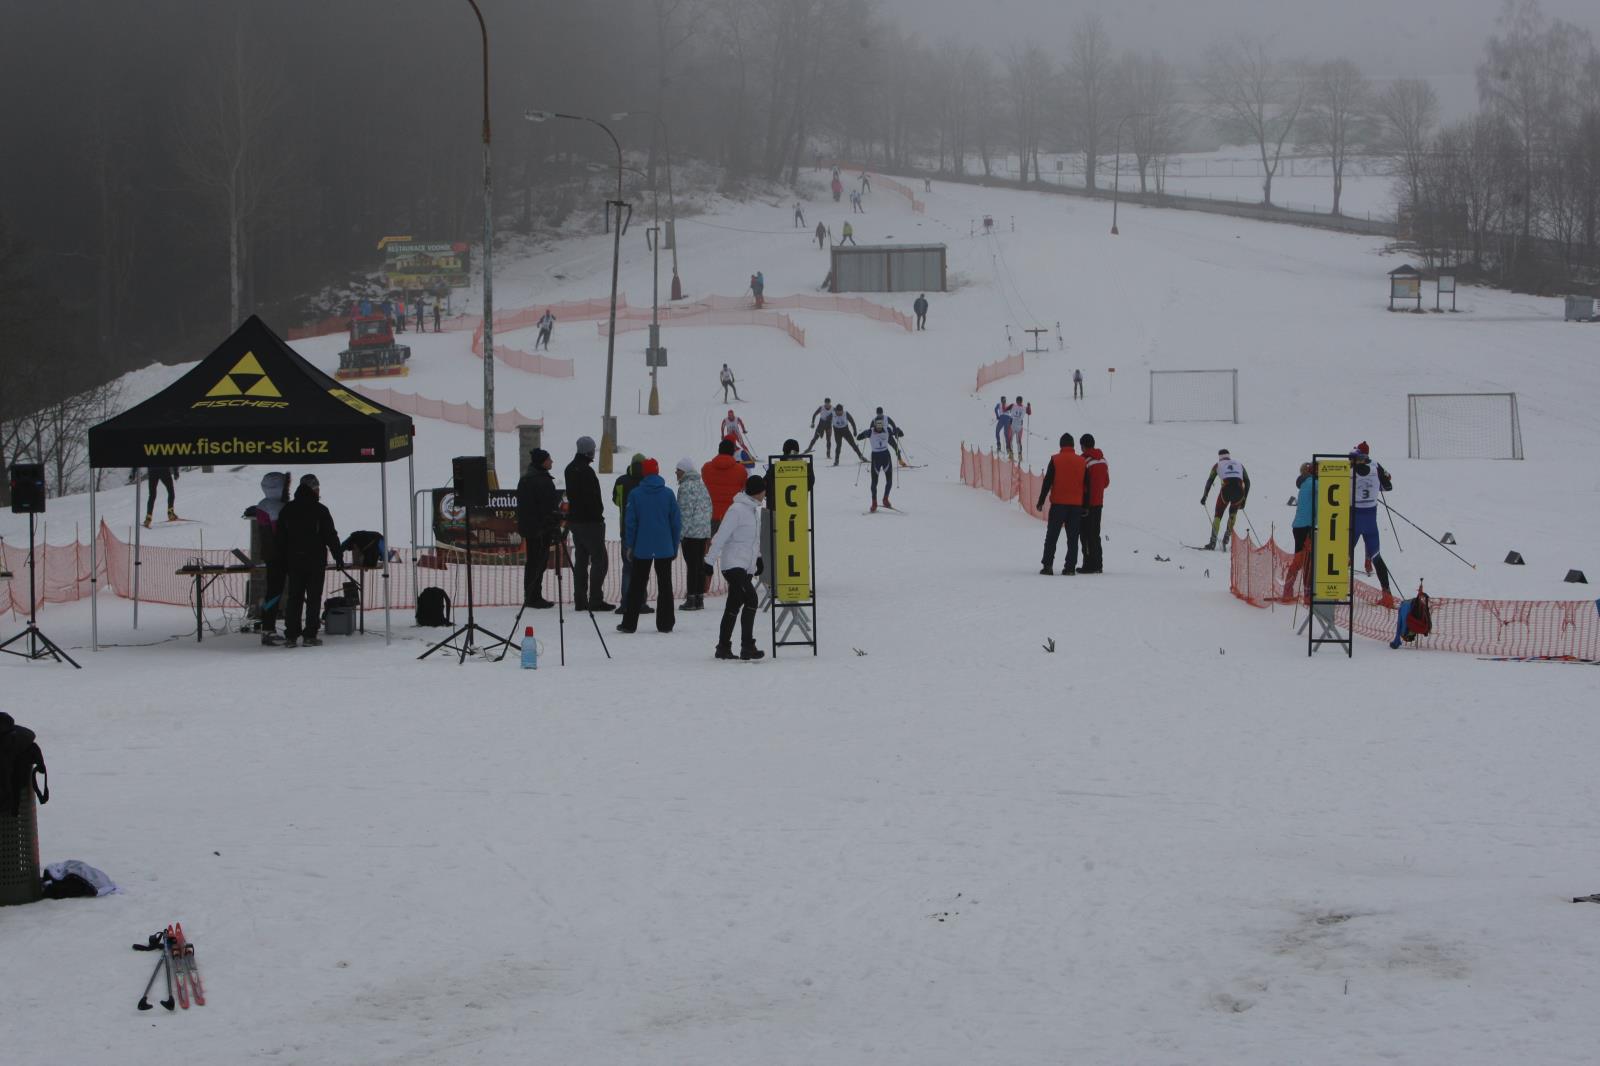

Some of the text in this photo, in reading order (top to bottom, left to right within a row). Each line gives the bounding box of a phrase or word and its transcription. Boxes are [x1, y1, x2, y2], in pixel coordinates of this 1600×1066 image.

[191, 399, 290, 408] FISCHER
[144, 437, 329, 456] www.fischer-ski.cz
[1362, 489, 1370, 499] 3
[785, 485, 800, 577] CÍL
[1328, 484, 1340, 575] CÍL
